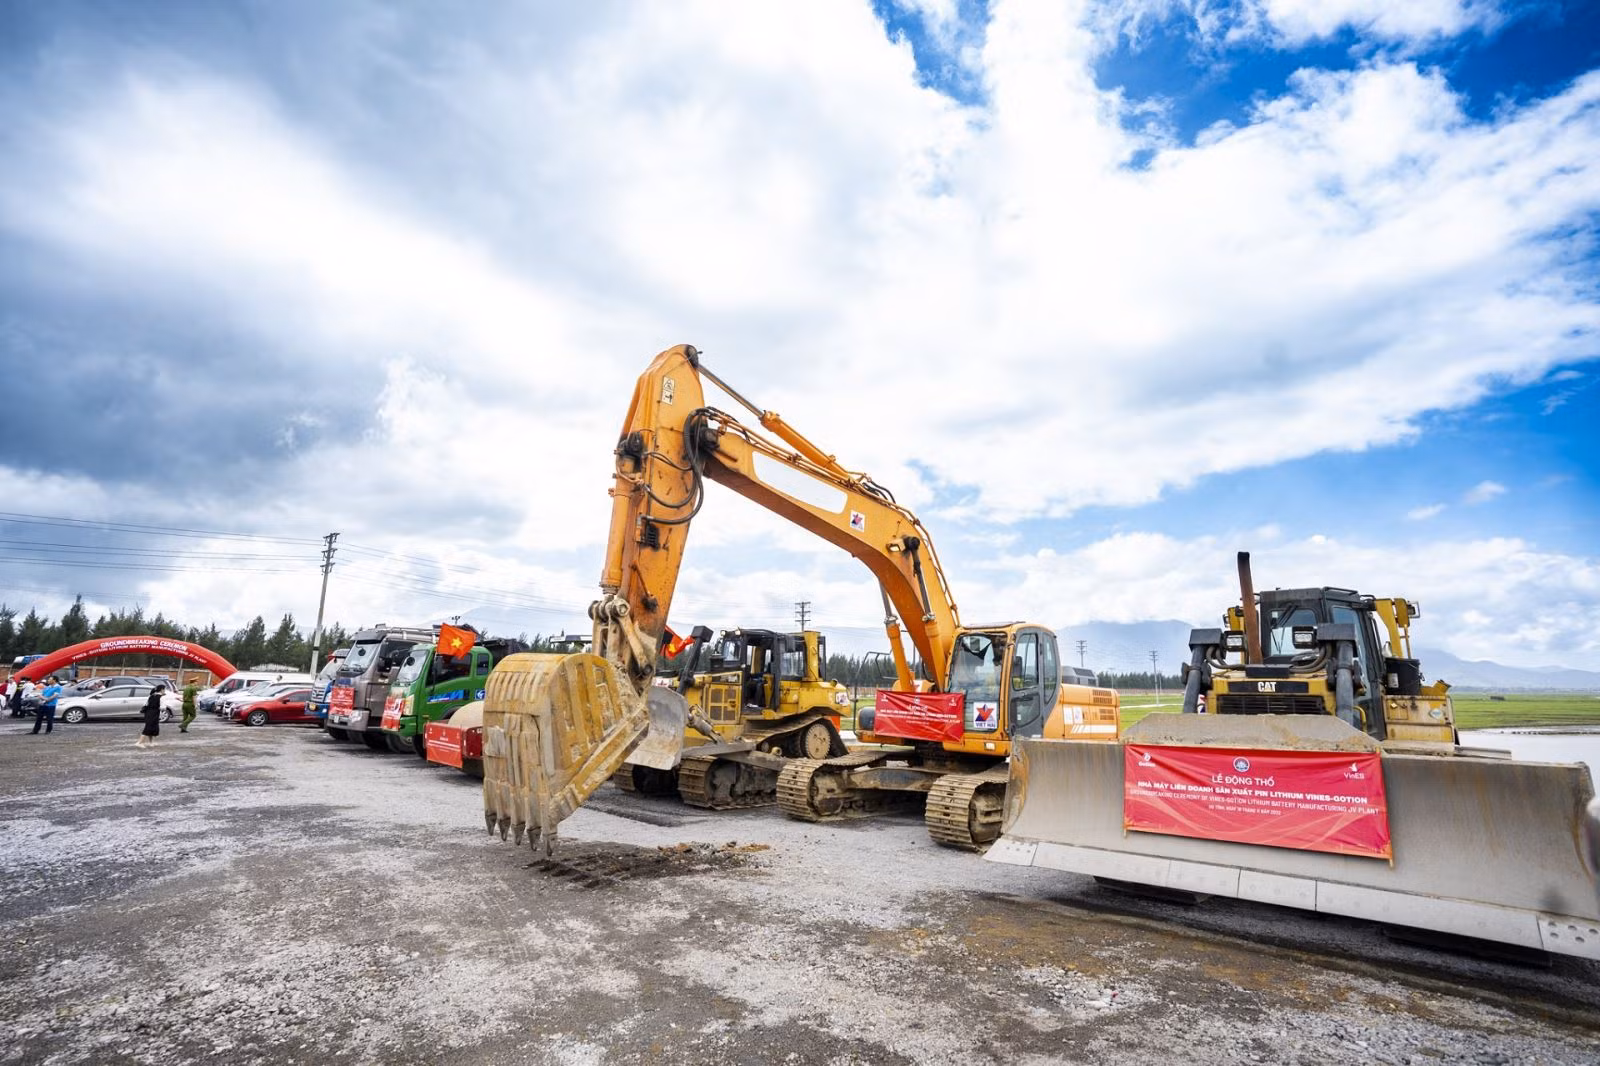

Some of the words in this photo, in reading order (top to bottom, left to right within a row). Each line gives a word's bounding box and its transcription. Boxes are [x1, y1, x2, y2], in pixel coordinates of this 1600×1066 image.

[100, 639, 158, 648] GROUNDBREAKING
[1257, 681, 1277, 692] CAT
[1187, 785, 1213, 793] DOANH
[1270, 791, 1303, 800] LITHIUM
[1305, 793, 1367, 804] VINES-GOTION
[1248, 798, 1270, 806] LITHIUM
[1271, 800, 1296, 808] BATTERY
[1297, 802, 1346, 812] MANUFACTURING
[1358, 807, 1379, 816] PLANT
